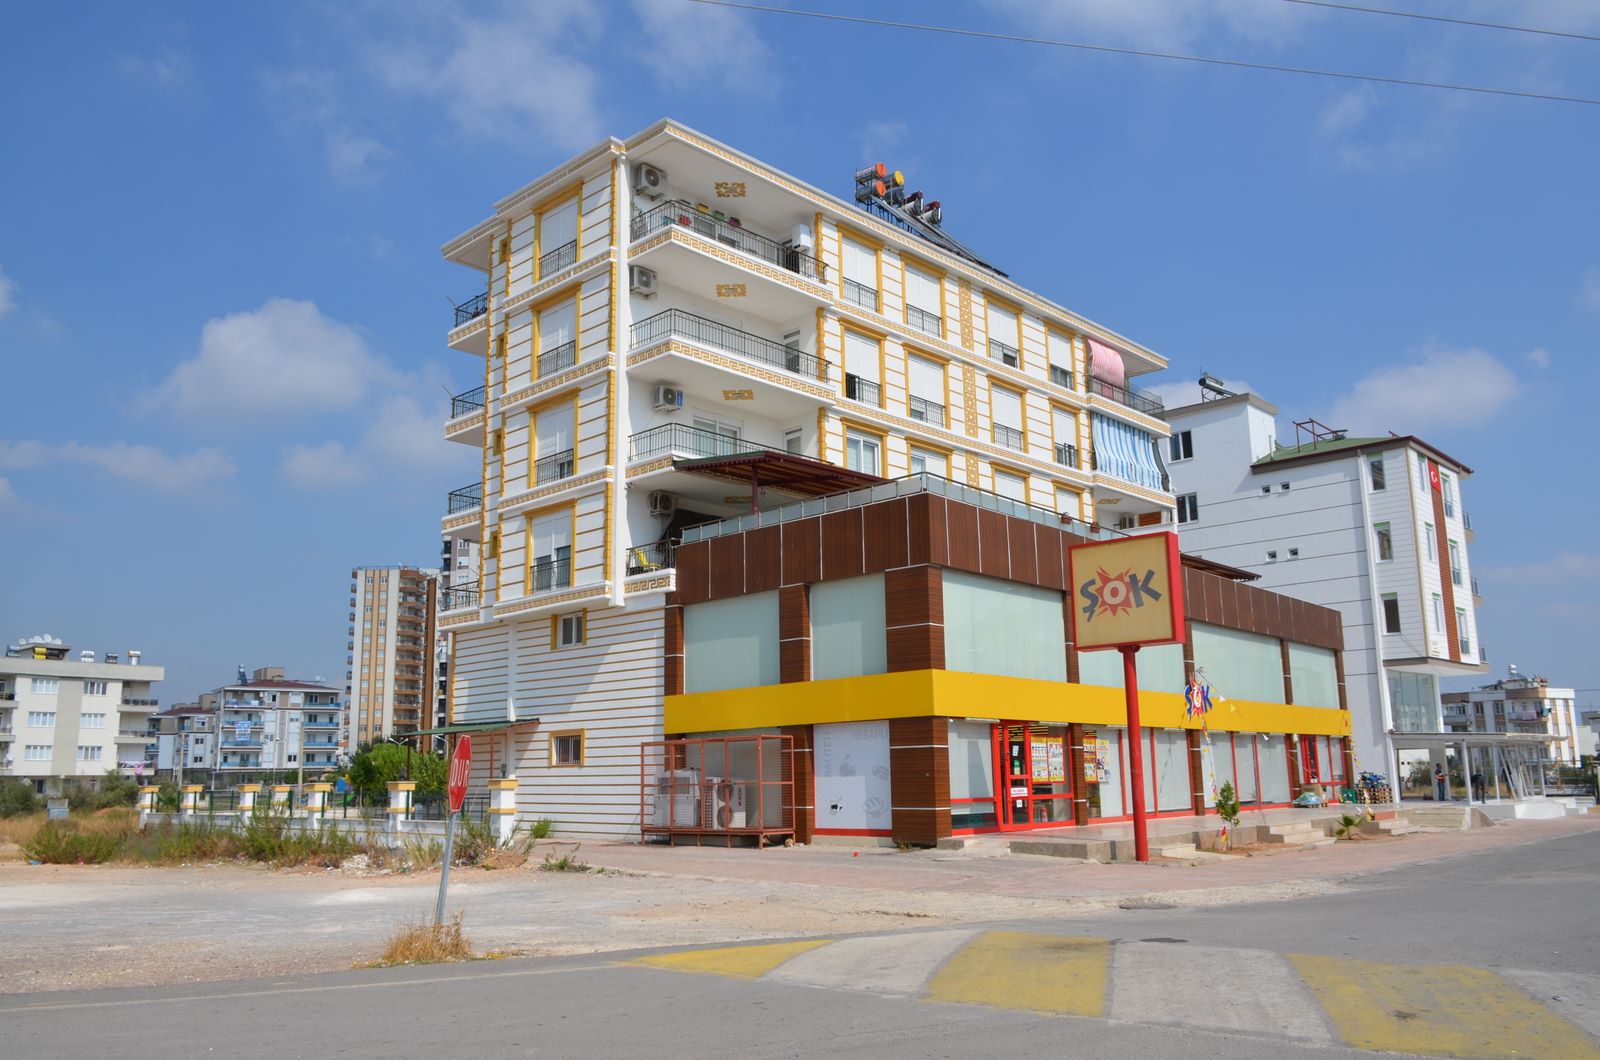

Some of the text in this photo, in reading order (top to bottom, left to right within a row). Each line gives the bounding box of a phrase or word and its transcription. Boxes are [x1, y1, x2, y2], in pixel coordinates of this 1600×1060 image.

[1080, 569, 1162, 623] ŞOK
[1185, 684, 1213, 722] ŞOK
[451, 759, 470, 787] DUR
